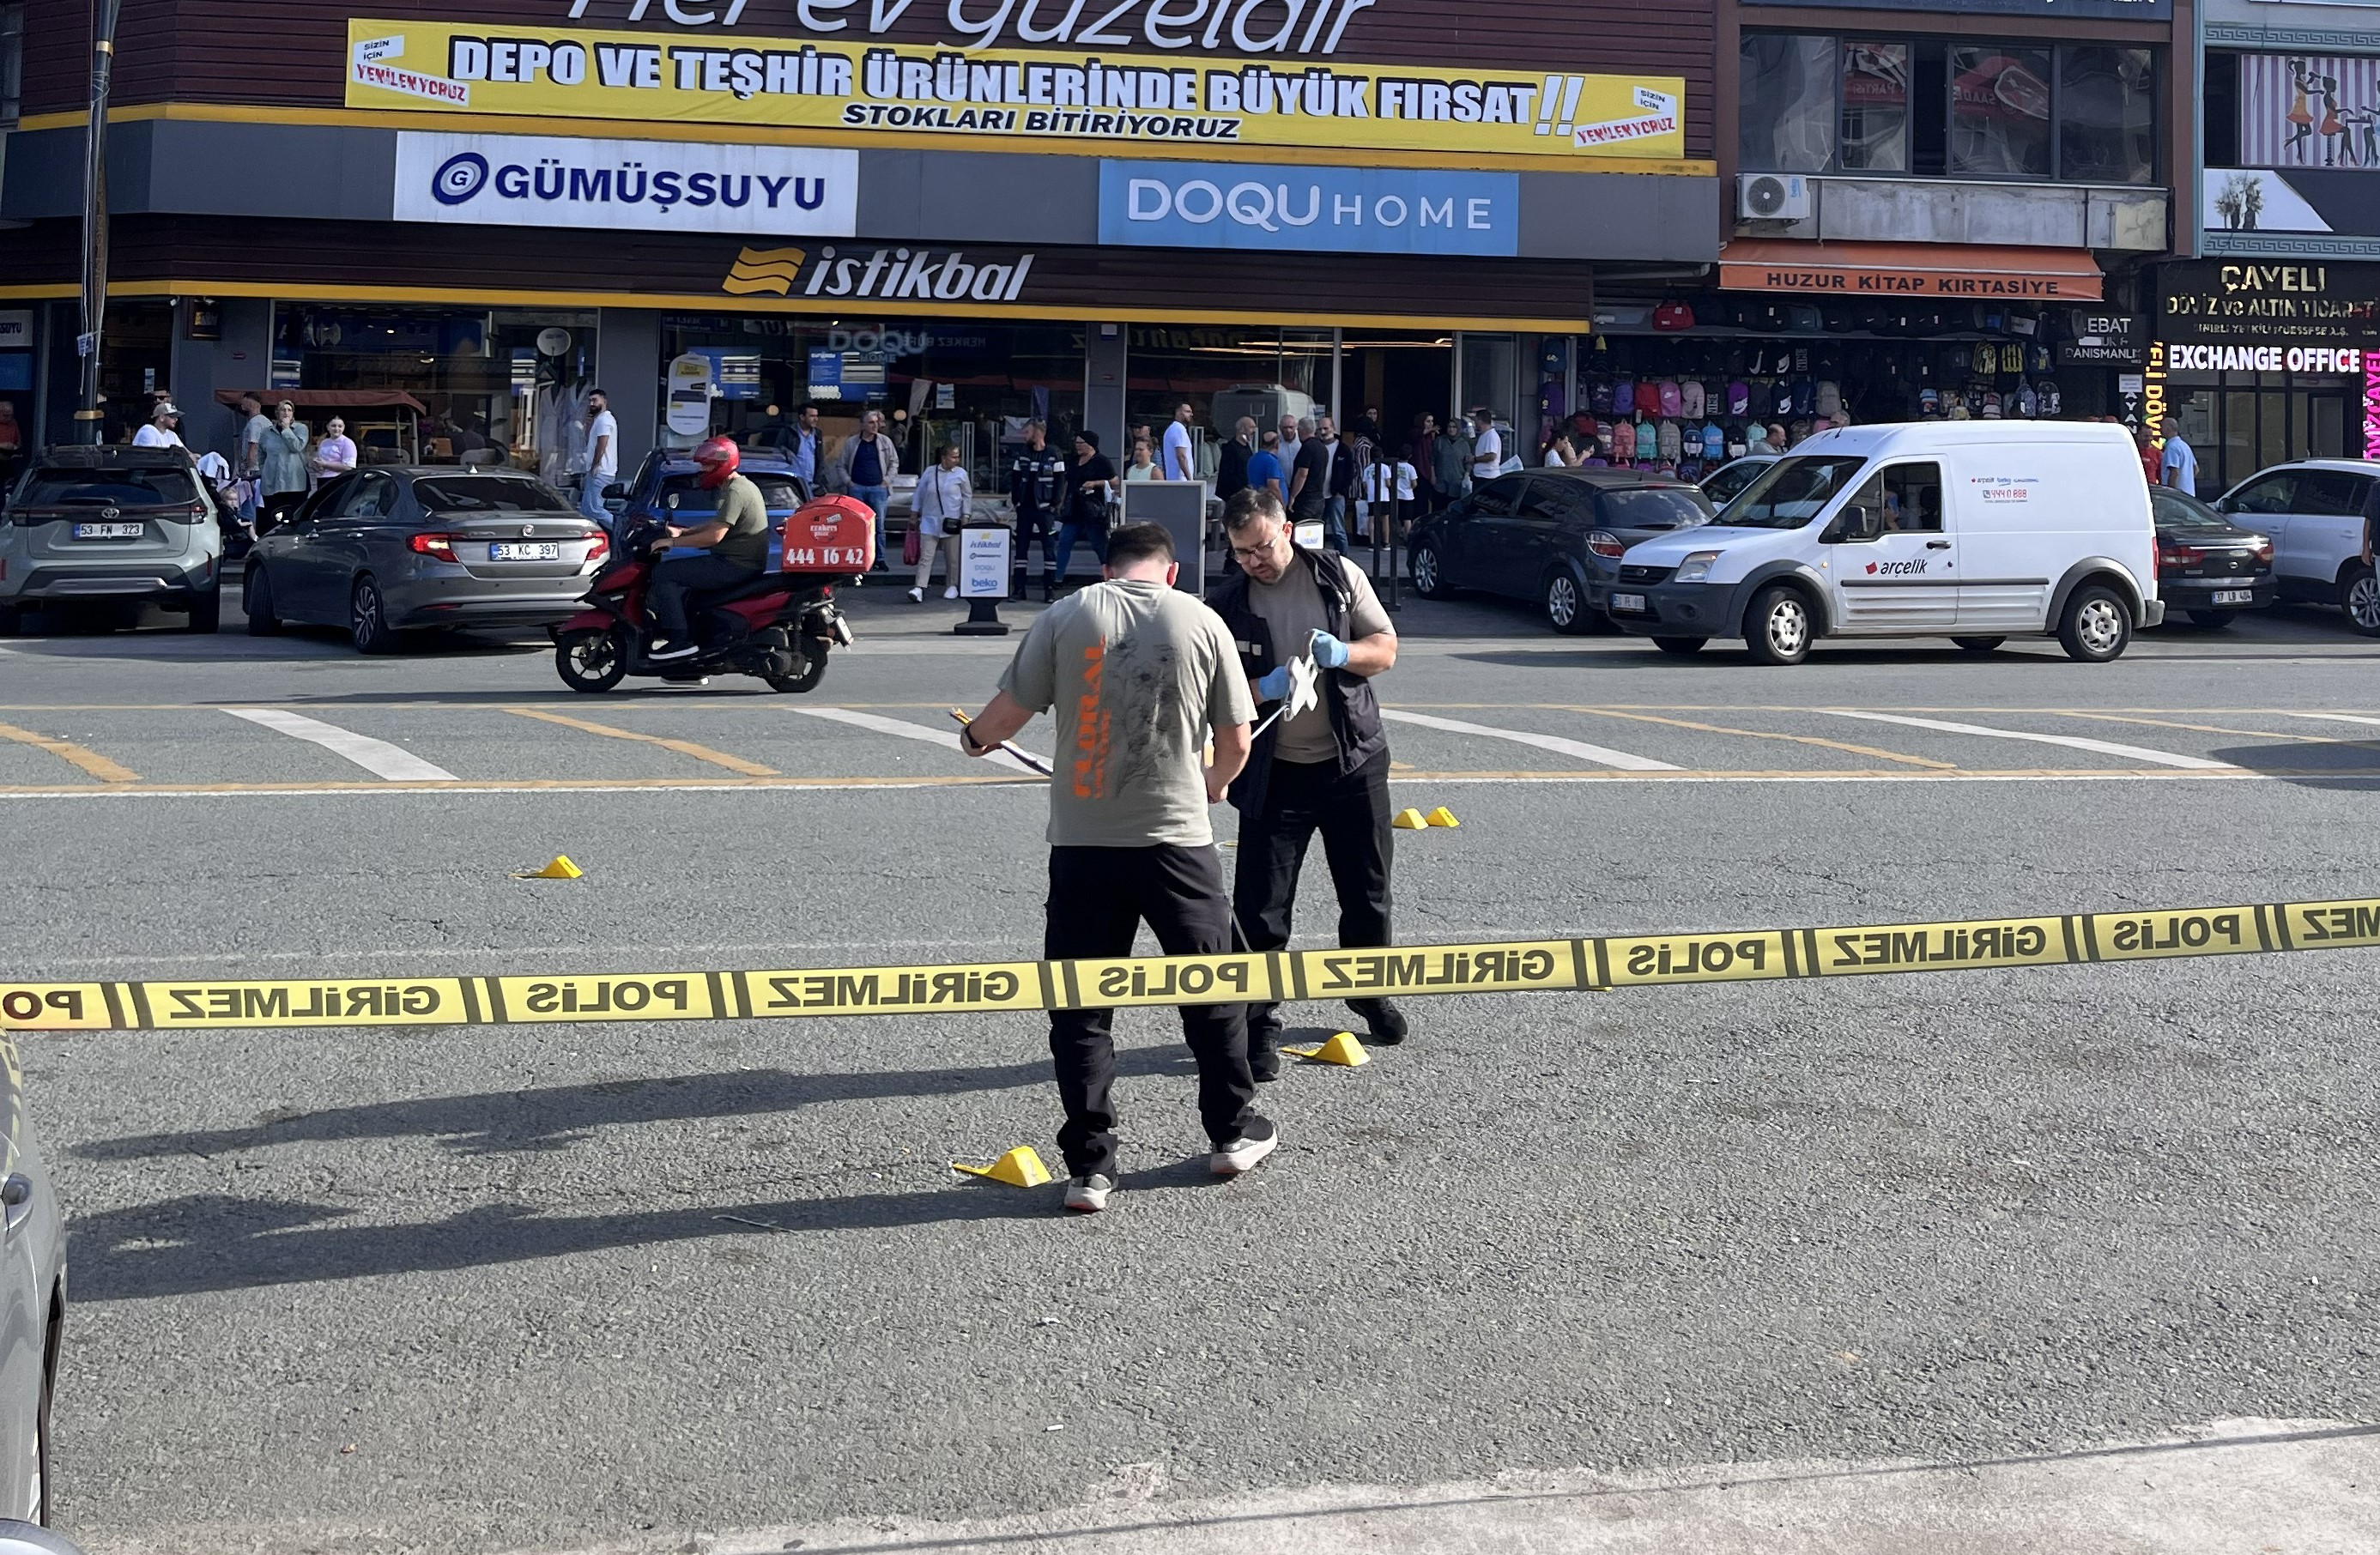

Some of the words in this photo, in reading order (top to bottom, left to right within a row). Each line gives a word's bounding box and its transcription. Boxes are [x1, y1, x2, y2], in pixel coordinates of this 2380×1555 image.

[448, 35, 586, 86] DEPO
[594, 43, 661, 89] VE
[668, 45, 853, 100] TEŞHİR
[862, 47, 1197, 112] ÜRÜNLERİNDE
[1206, 65, 1369, 120] BÜYÜK
[843, 102, 1016, 131] STOKLARI
[1026, 105, 1242, 140] BİTİRİYORUZ
[495, 159, 826, 214] GÜMÜŞSUYU
[1128, 178, 1321, 233] DOQU
[1333, 193, 1493, 231] HOME
[804, 245, 1036, 302] istikbal
[1766, 271, 1846, 290] HUZUR
[1858, 272, 1925, 292] KİTAP
[1938, 275, 2059, 294] KIRTASİYE
[2248, 298, 2298, 318] ALTIN
[2084, 318, 2132, 334] EBAT
[828, 330, 928, 356] DOQU
[2170, 345, 2283, 372] EXCHANGE
[2287, 345, 2360, 372] OFFICE
[81, 524, 94, 535] 53
[122, 524, 140, 535] 323
[499, 545, 511, 556] 53
[518, 544, 531, 555] KC
[539, 544, 557, 555] 397
[786, 548, 815, 565] 444
[823, 548, 840, 565] 16
[845, 548, 864, 565] 42
[1880, 558, 1929, 580] arçelik
[972, 578, 998, 587] beko
